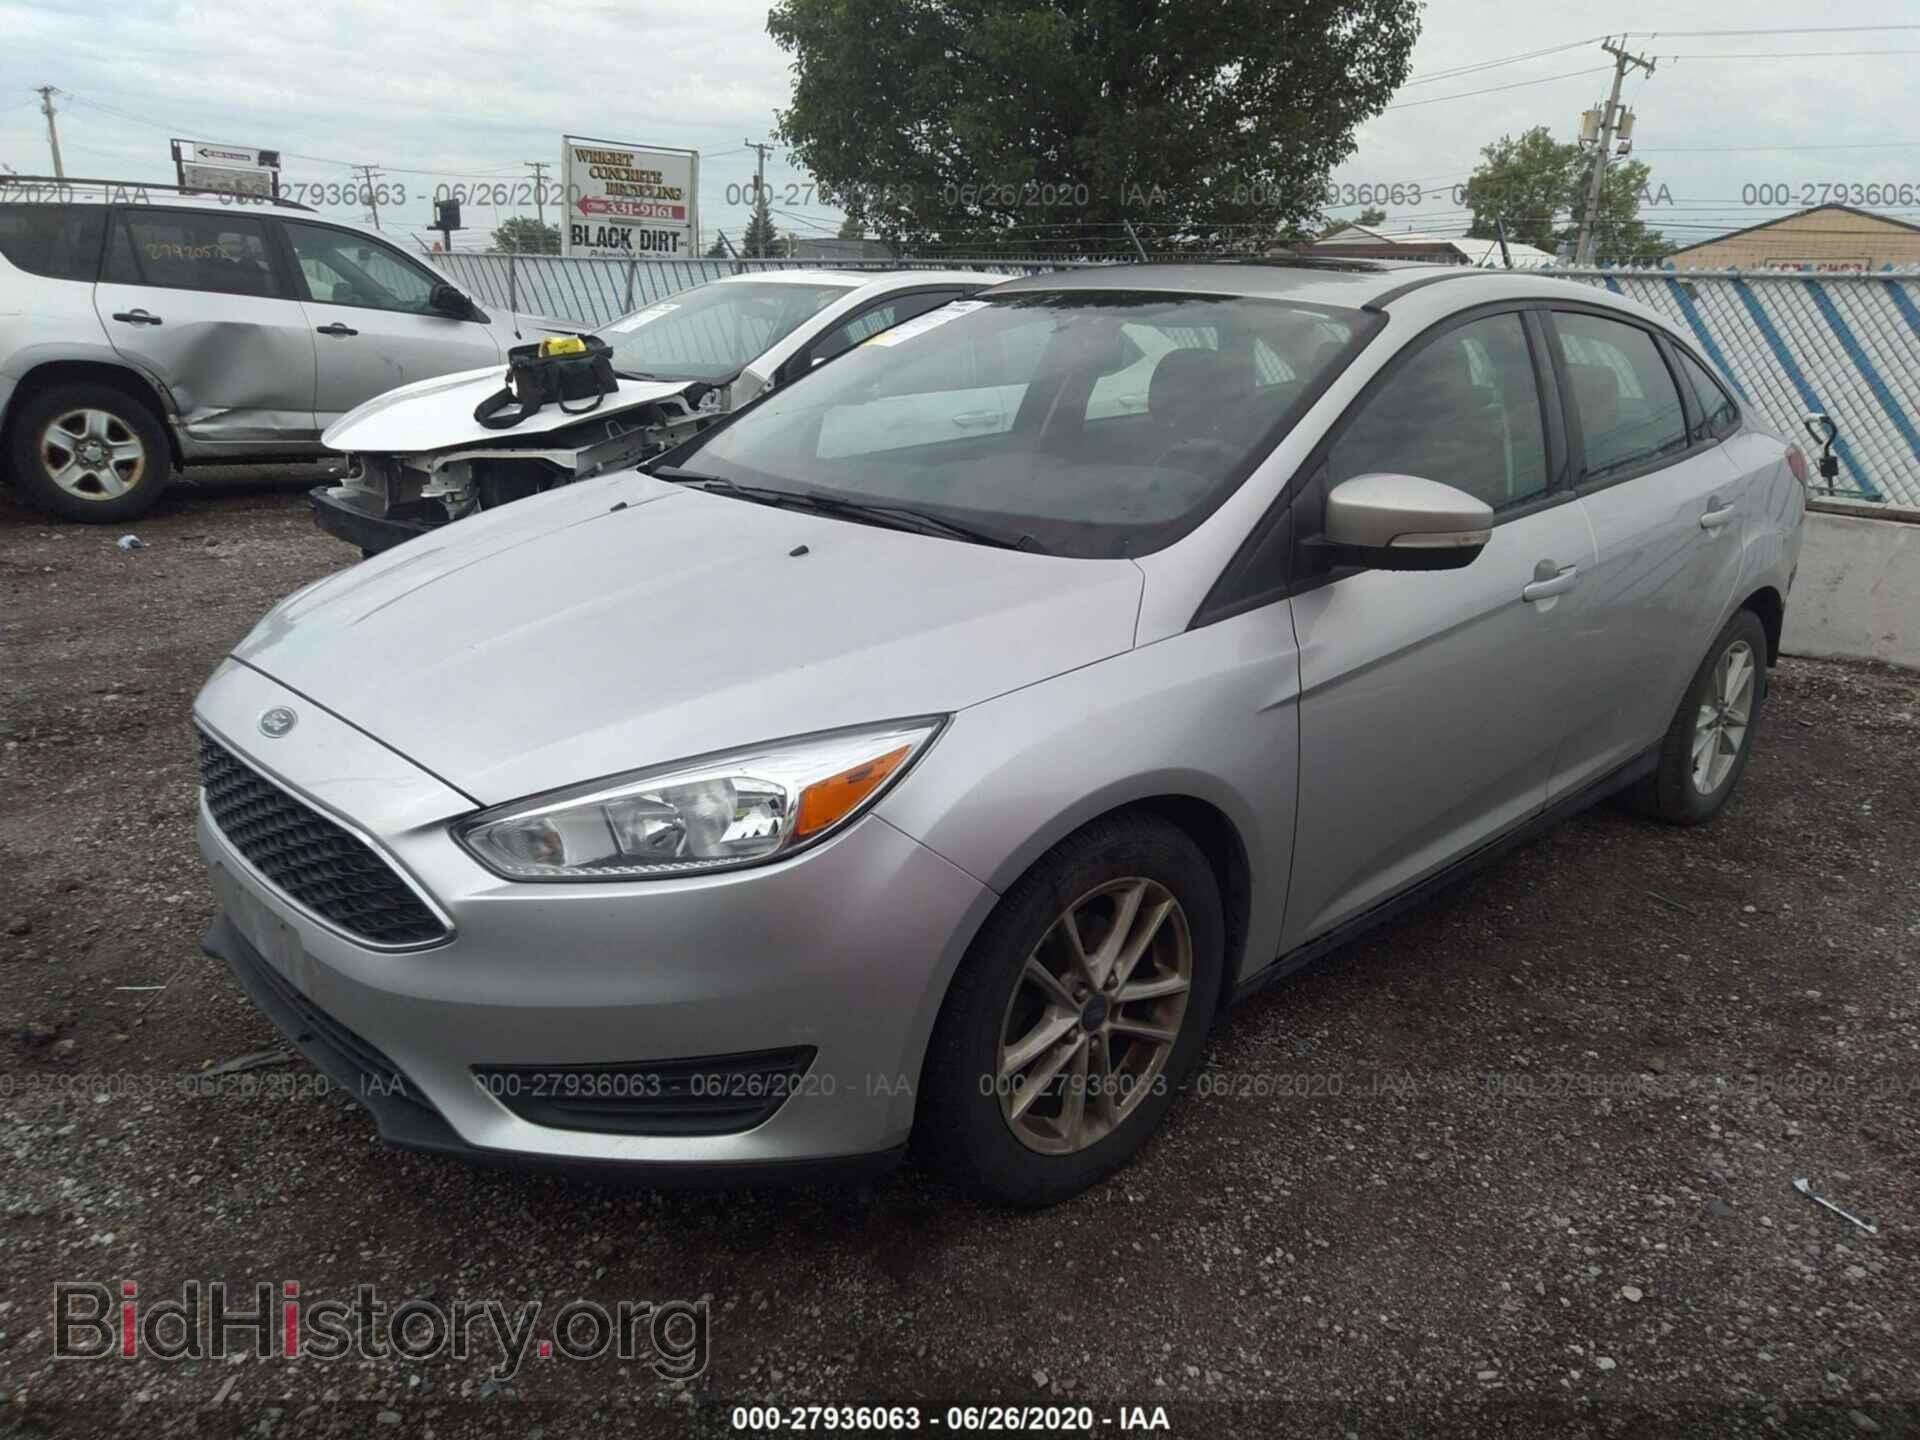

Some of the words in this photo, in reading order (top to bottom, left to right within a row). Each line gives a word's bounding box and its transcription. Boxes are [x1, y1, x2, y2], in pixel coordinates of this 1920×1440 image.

[576, 149, 633, 166] WRIGHT
[589, 166, 663, 184] CONCRETE
[606, 183, 681, 200] RECYCLING
[607, 202, 673, 219] 331-9161
[571, 224, 633, 250] BLACK
[640, 229, 680, 253] DIRT
